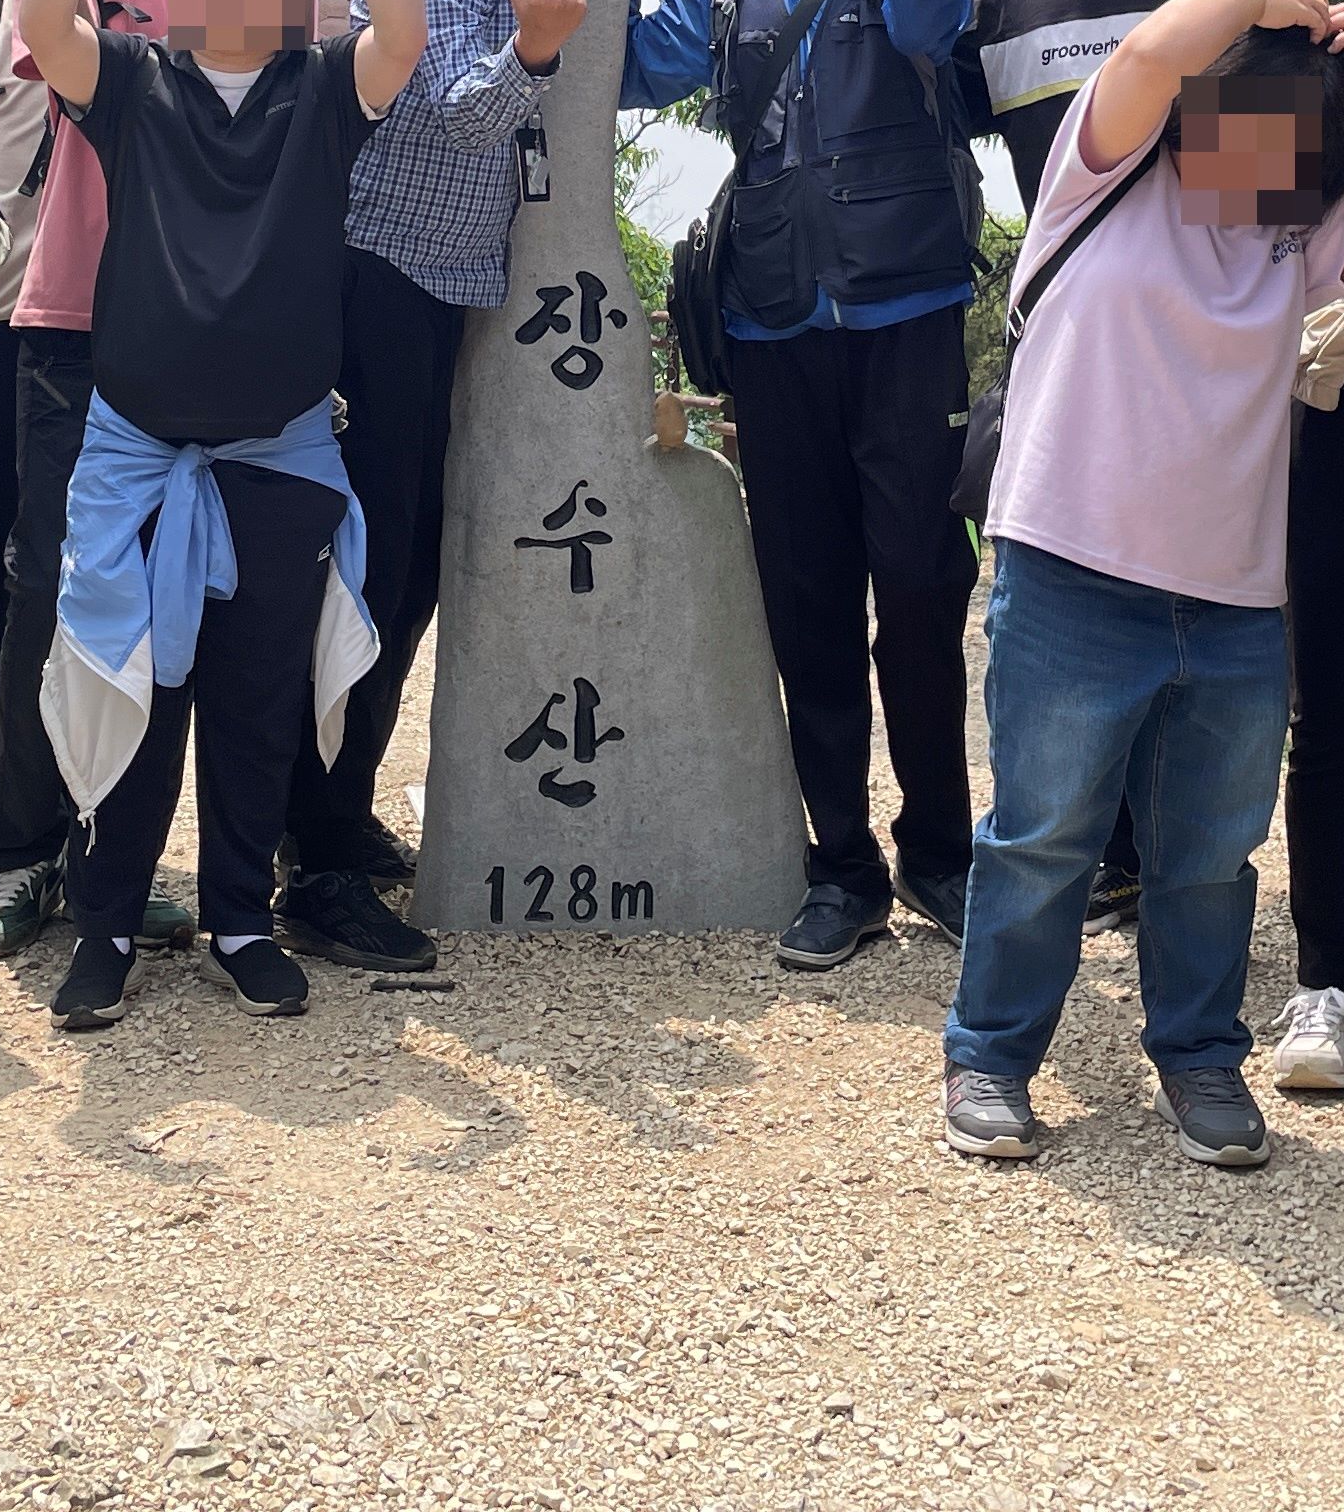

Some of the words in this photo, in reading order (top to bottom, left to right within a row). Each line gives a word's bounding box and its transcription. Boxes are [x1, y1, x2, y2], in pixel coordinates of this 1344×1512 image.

[1041, 36, 1124, 66] grooverh
[504, 270, 628, 808] 장수산
[484, 864, 654, 925] 128m
